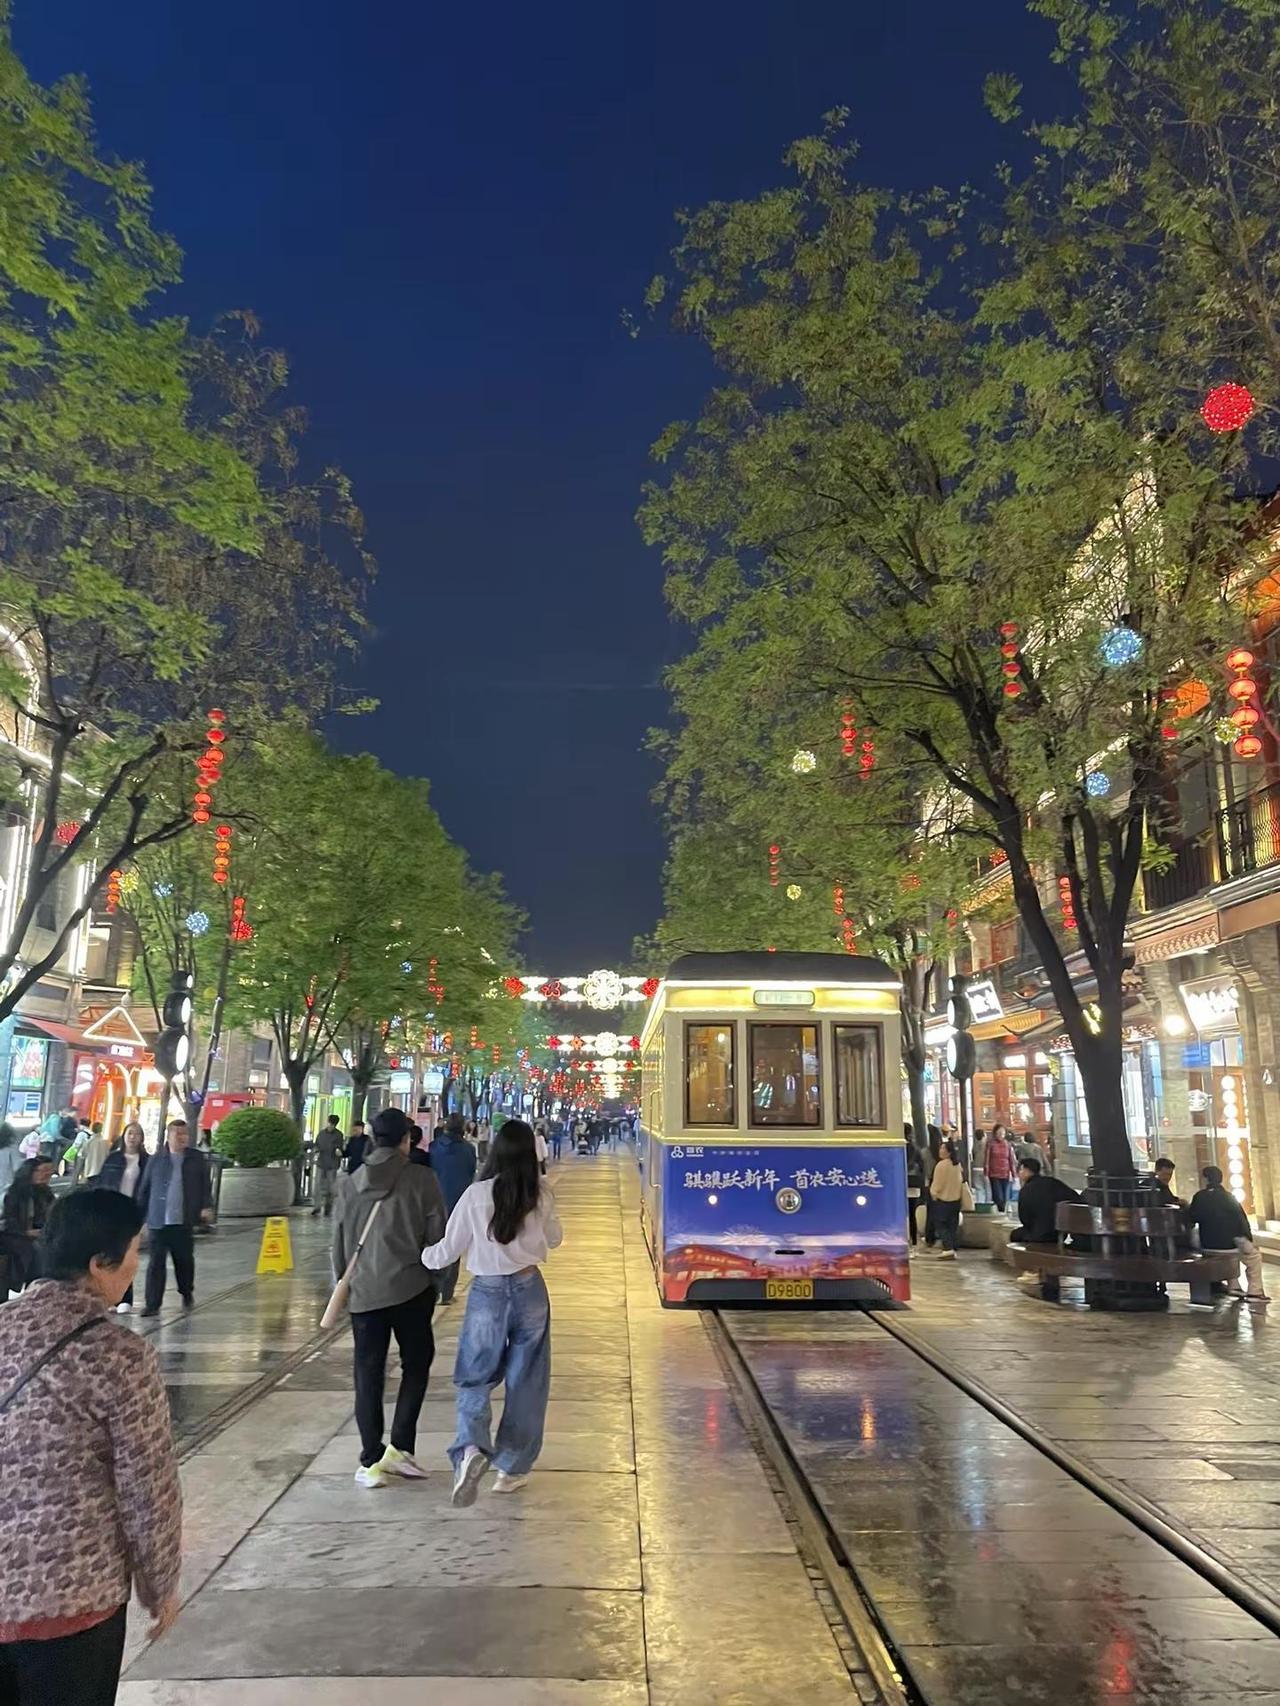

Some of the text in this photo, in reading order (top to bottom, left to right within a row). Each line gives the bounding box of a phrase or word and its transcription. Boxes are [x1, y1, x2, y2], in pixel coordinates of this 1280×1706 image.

[789, 1167, 884, 1190] 首农安心选
[768, 1284, 812, 1298] D9800
